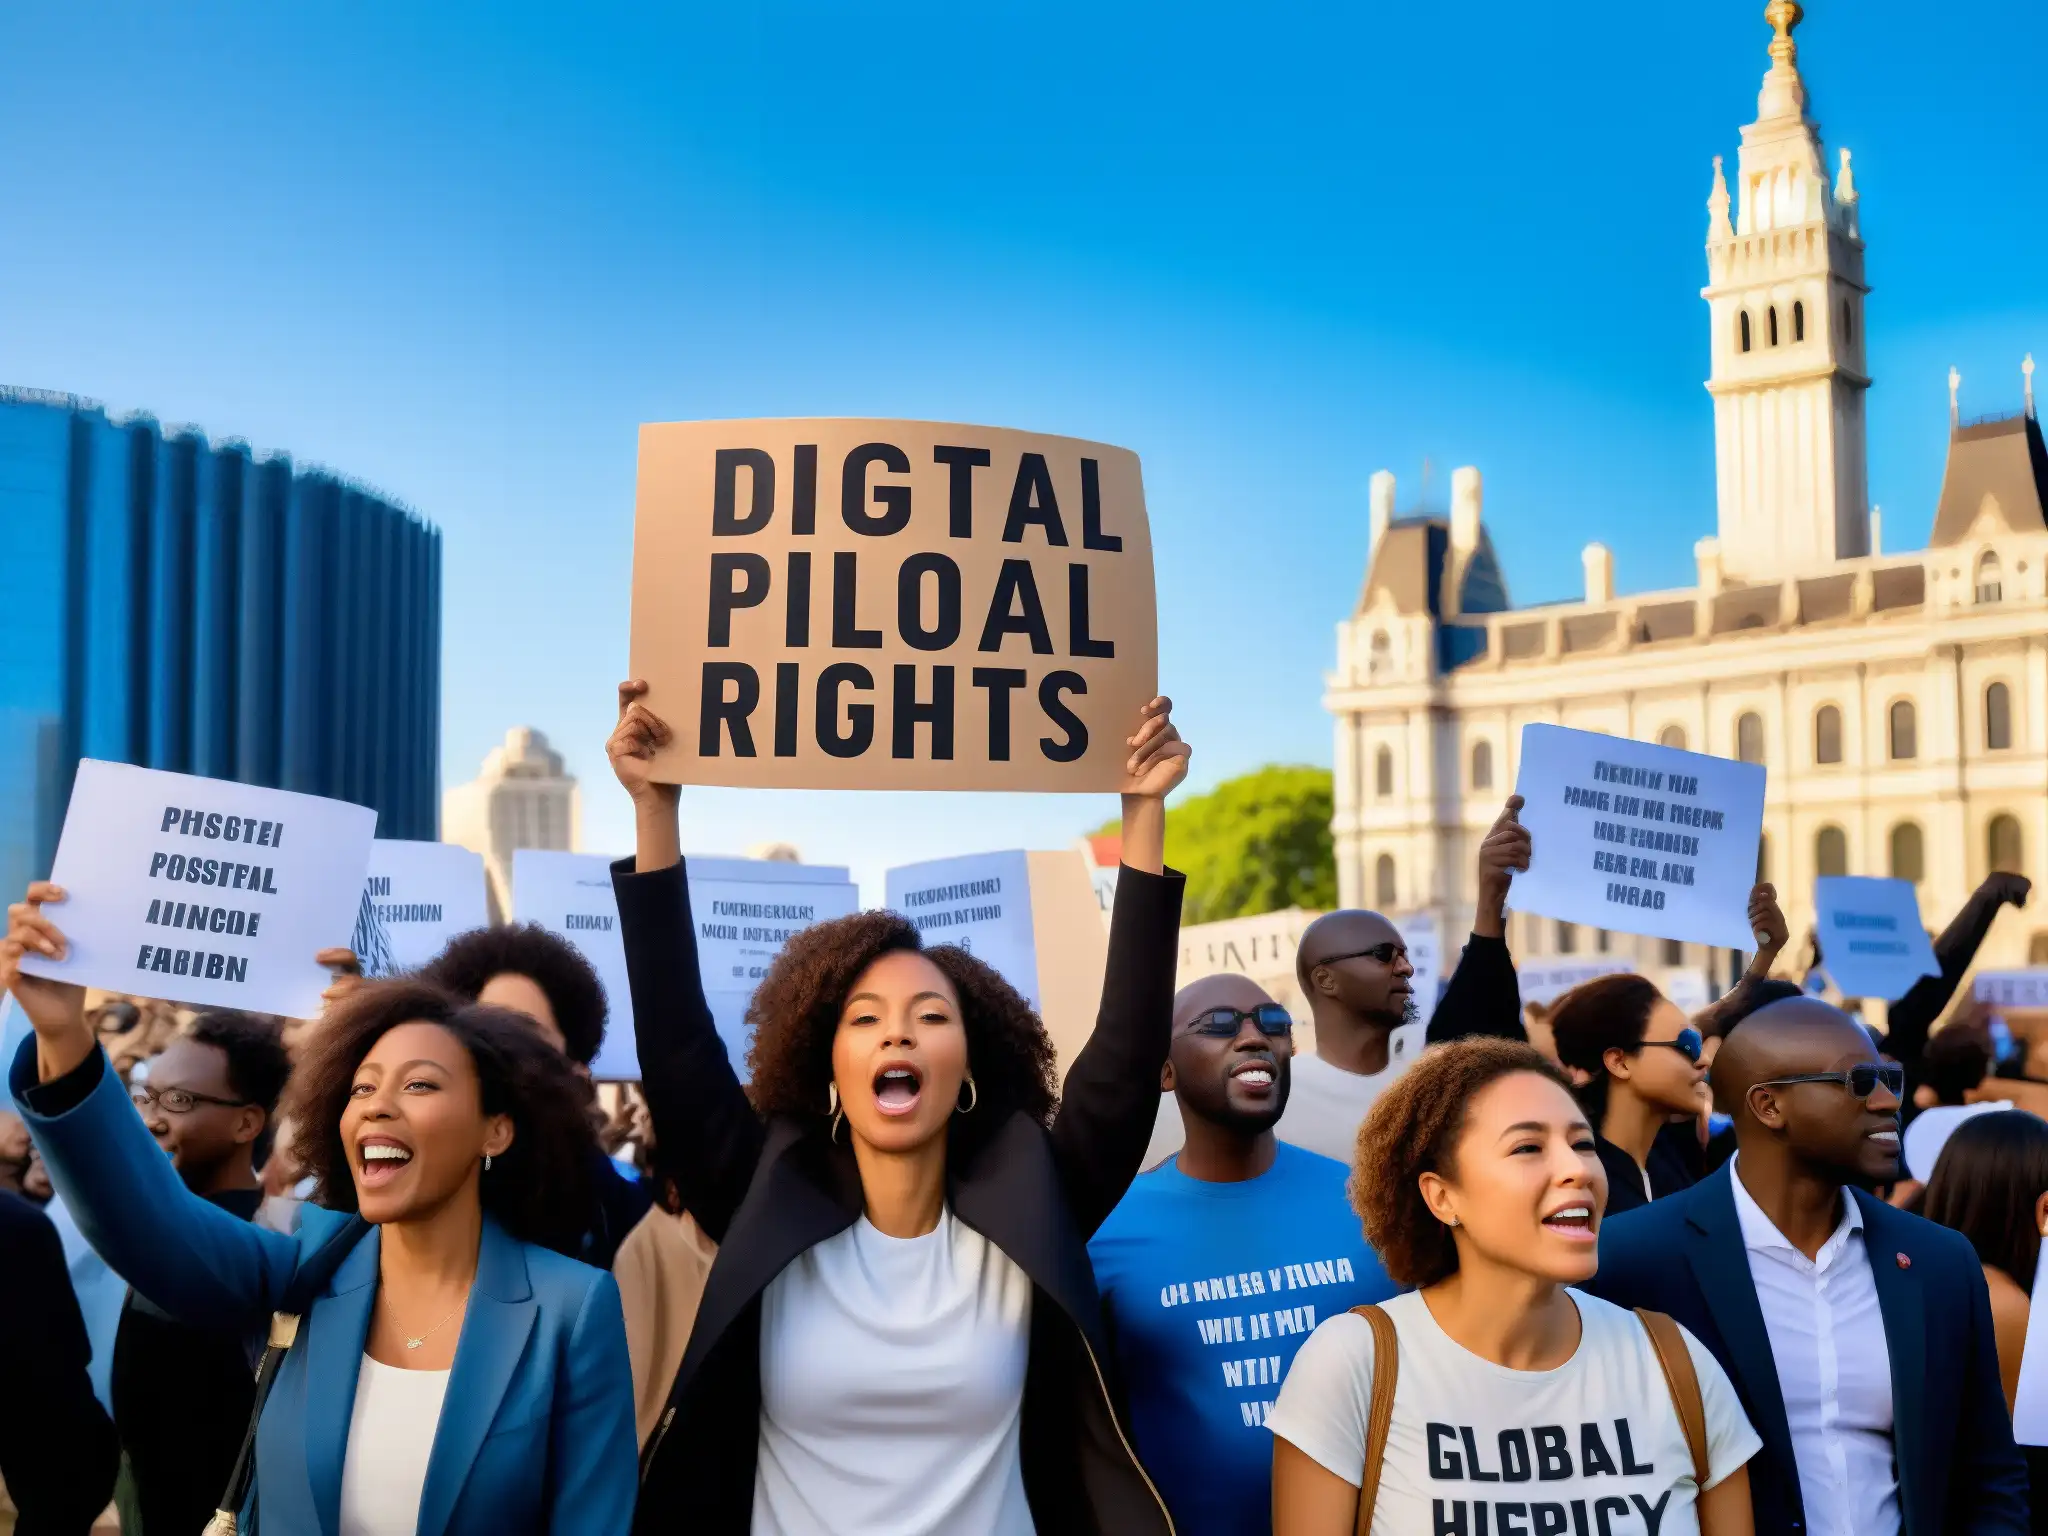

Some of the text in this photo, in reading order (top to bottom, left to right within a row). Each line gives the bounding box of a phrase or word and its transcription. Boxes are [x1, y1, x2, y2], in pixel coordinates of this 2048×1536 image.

[712, 443, 1122, 552] DIGTAL
[707, 552, 1115, 658] PILOAL
[699, 662, 1088, 763] RIGHTS
[1426, 1417, 1654, 1482] GLOBAL
